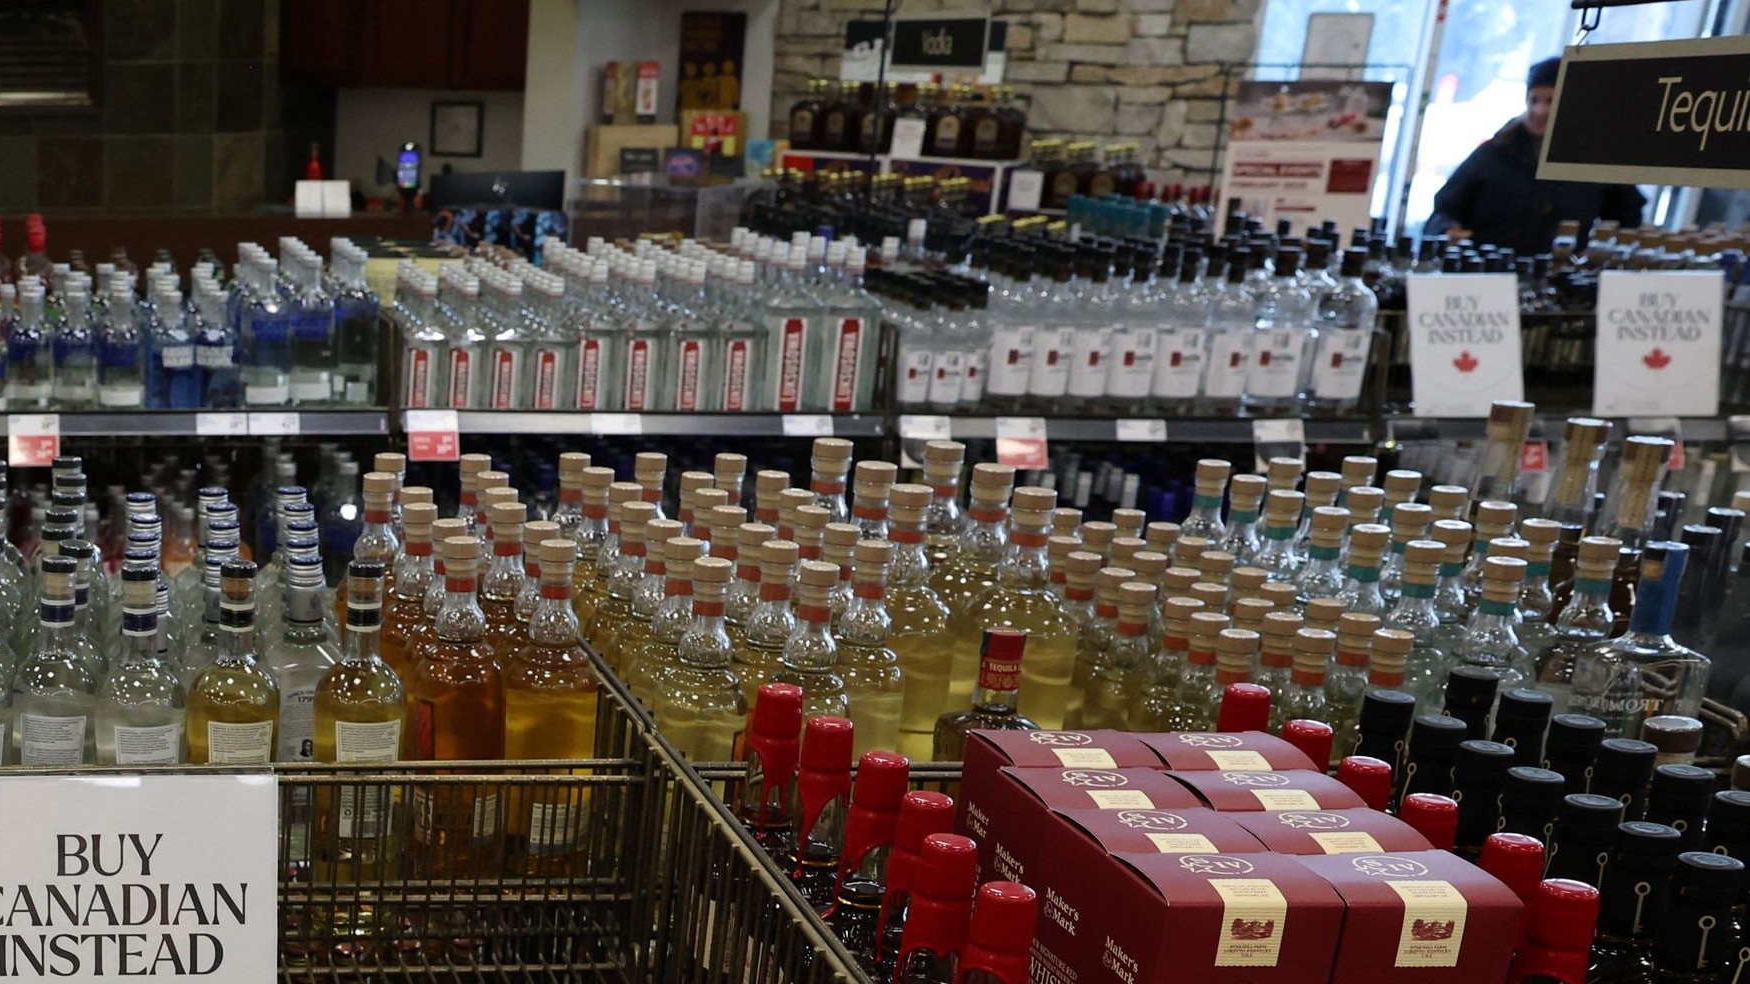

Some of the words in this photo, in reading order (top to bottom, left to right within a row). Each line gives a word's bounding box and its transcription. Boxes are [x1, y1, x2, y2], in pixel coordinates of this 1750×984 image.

[921, 26, 953, 55] Vodka
[1445, 295, 1480, 310] BUY
[1640, 293, 1679, 309] BUY
[1418, 312, 1510, 328] CANADIAN
[1608, 307, 1711, 324] CANADIAN
[1428, 329, 1503, 345] INSTEAD
[1617, 324, 1702, 342] INSTEAD
[989, 663, 1018, 672] TEQUILA
[56, 833, 164, 876] BUY
[995, 842, 1024, 875] Maker's
[1046, 886, 1080, 922] Maker's
[1051, 911, 1076, 936] Mark
[1105, 935, 1139, 973] Maker's
